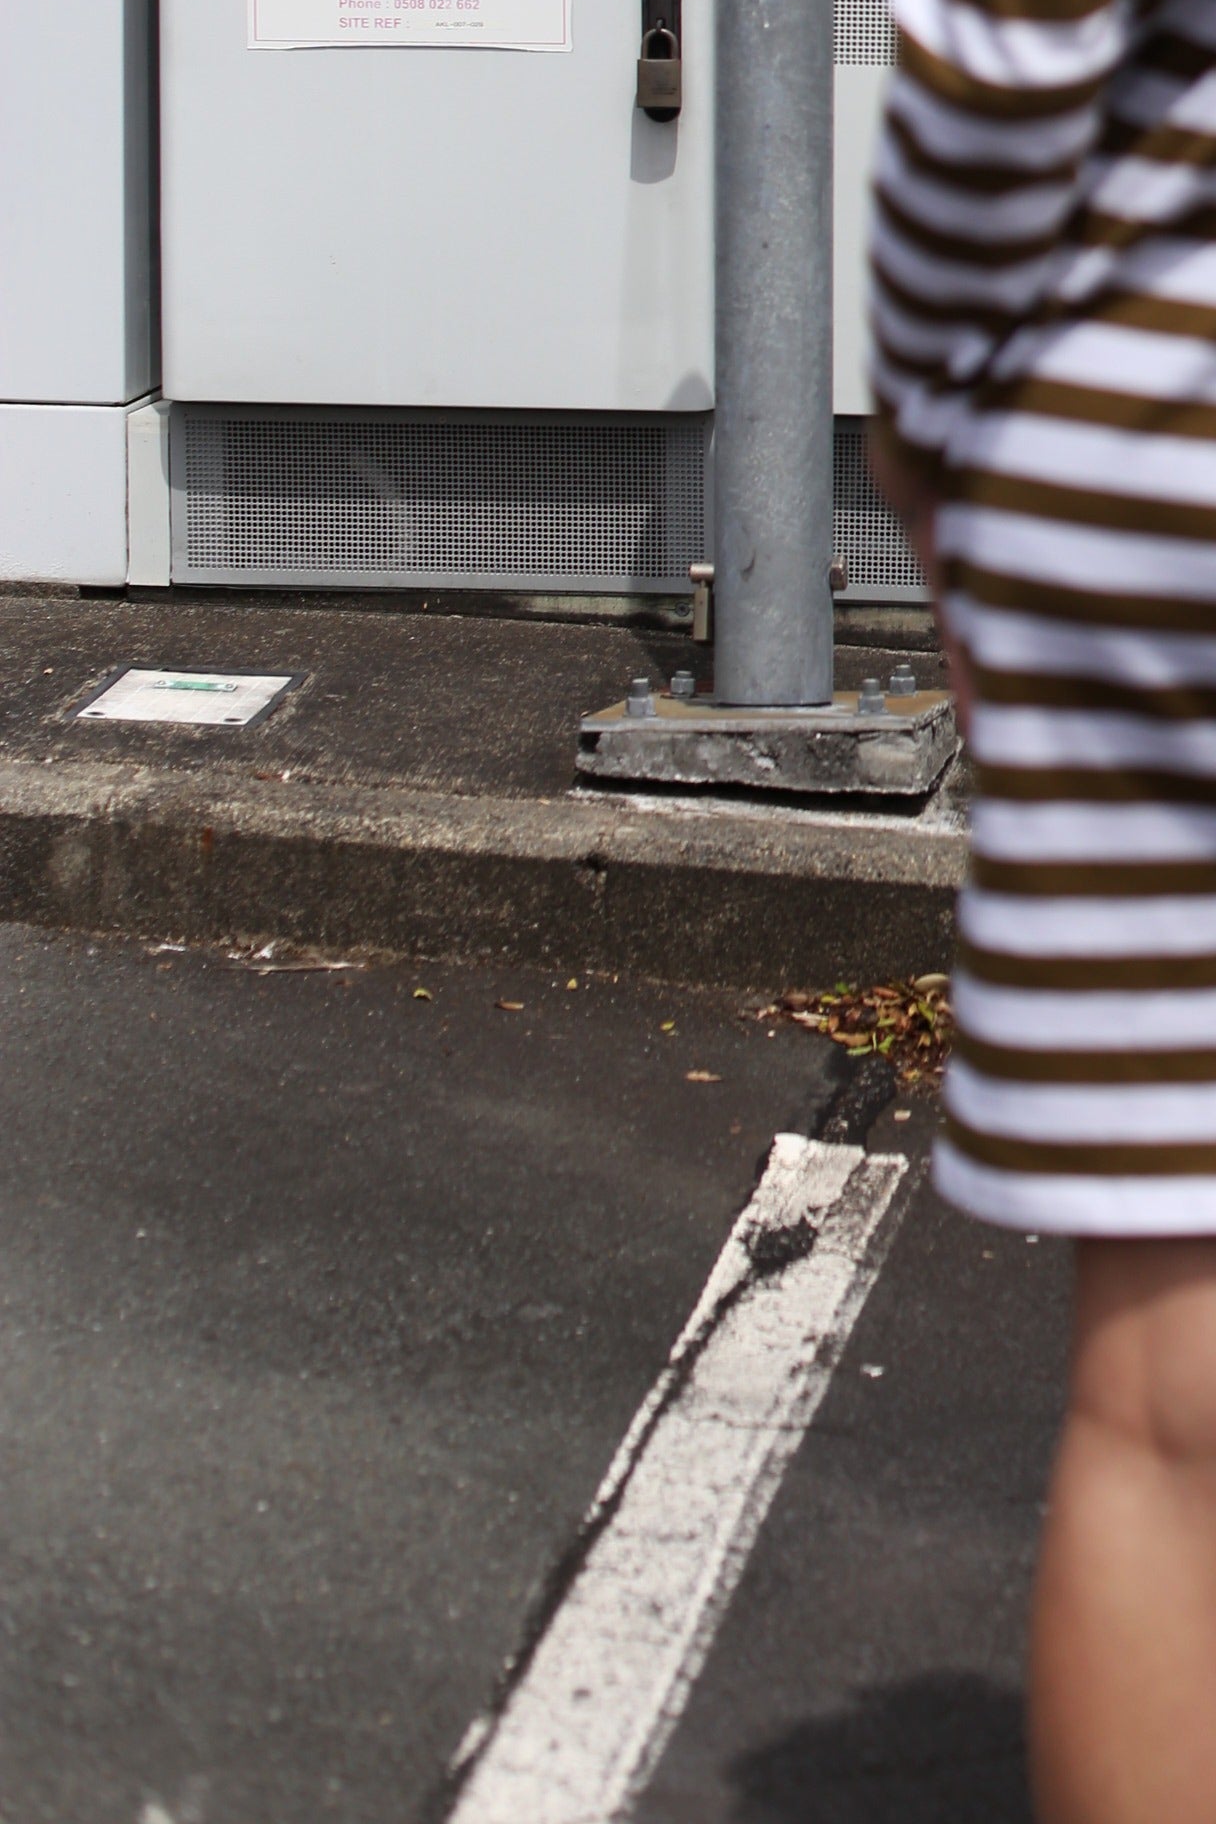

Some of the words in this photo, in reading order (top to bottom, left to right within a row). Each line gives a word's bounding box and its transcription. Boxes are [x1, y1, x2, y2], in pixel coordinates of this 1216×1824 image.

[456, 0, 480, 10] 662
[339, 17, 369, 29] SITE
[374, 18, 402, 29] REF
